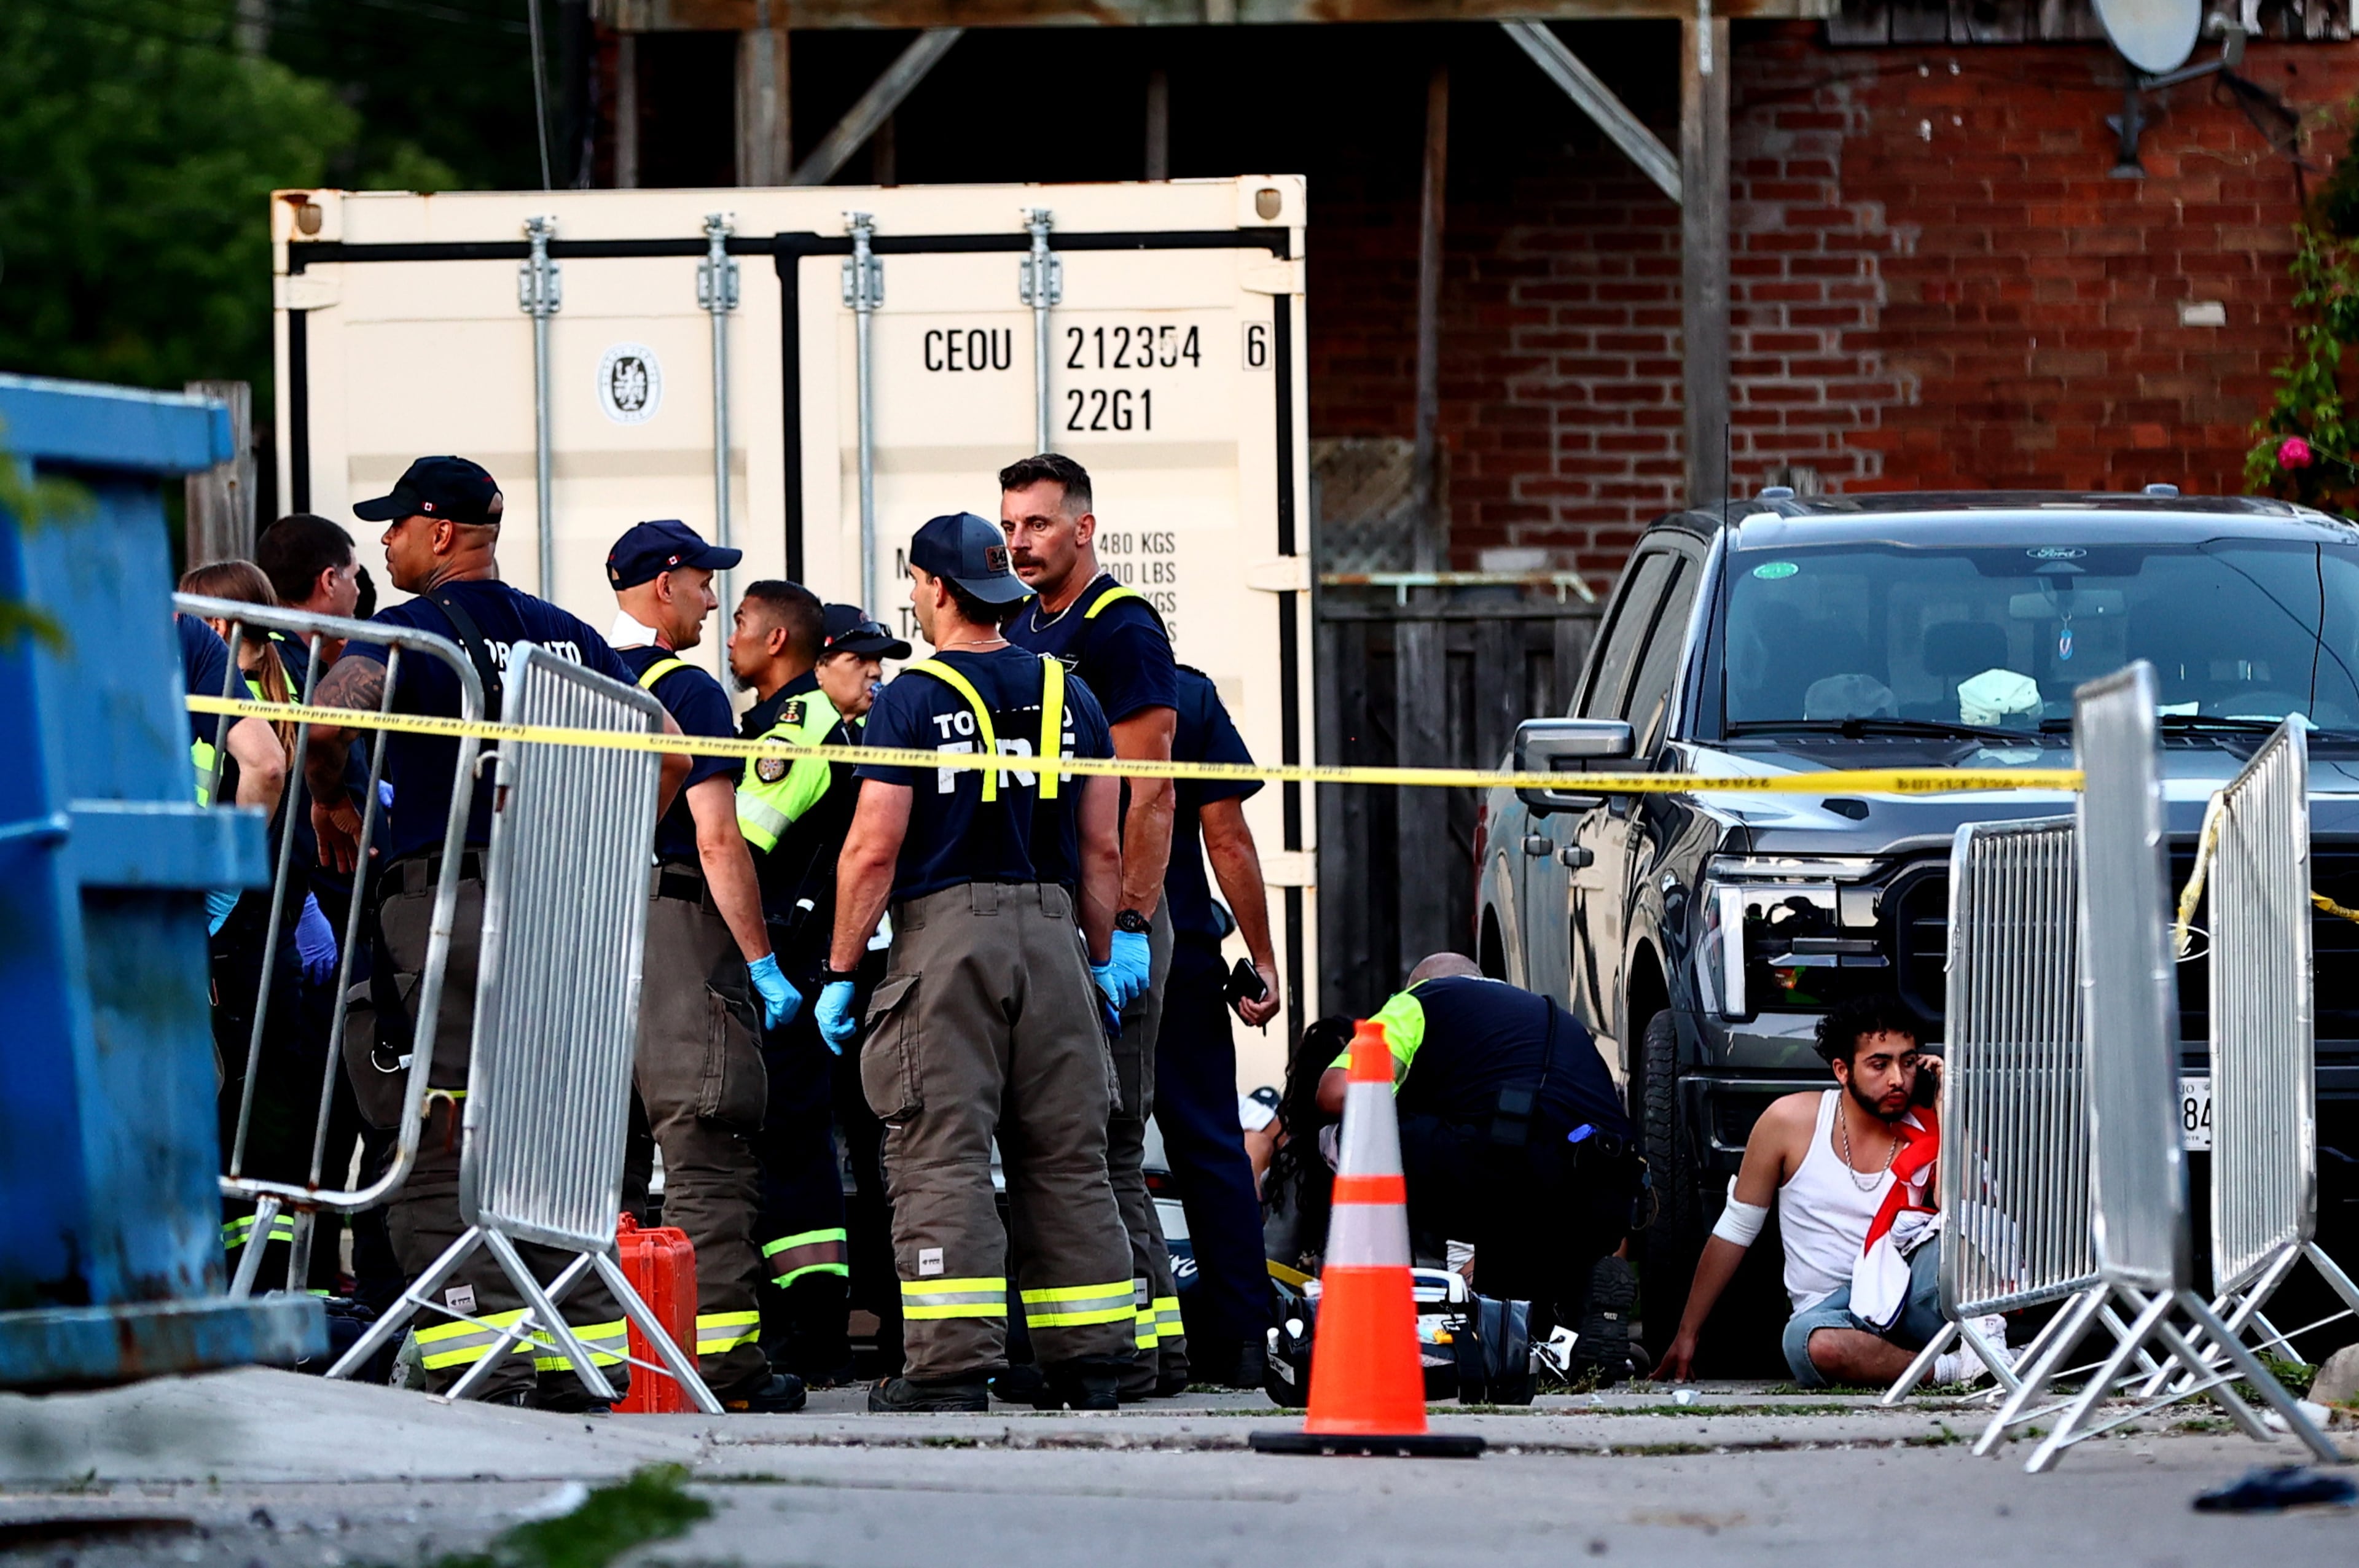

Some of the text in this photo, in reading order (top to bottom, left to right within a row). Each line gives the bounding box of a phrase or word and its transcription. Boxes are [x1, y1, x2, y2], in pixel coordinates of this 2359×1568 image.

[924, 325, 1267, 371] CEOU 212354 6
[1066, 388, 1152, 431] 22G1
[1141, 532, 1176, 555] KGS
[1141, 561, 1176, 584] LBS
[238, 703, 281, 714] Crime
[286, 708, 353, 721] Stoppers
